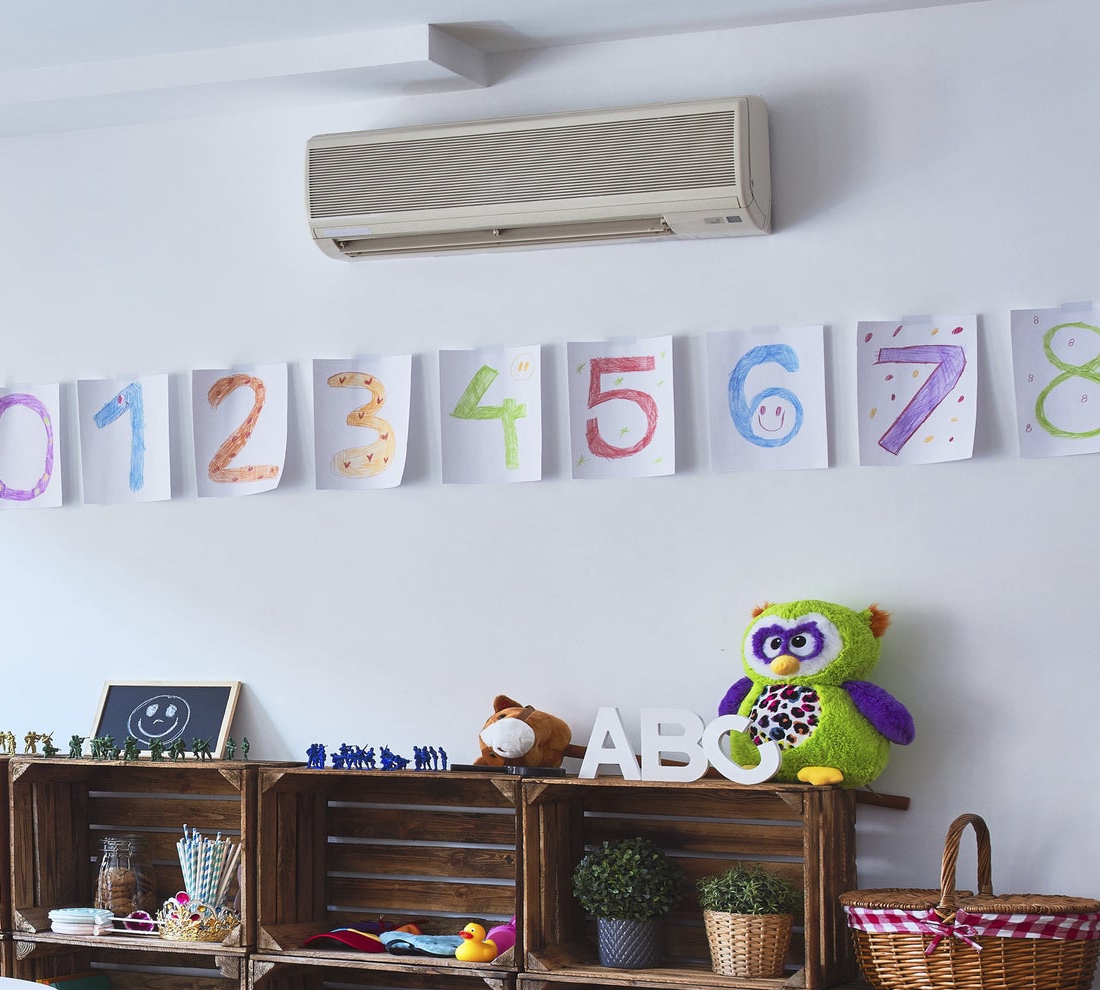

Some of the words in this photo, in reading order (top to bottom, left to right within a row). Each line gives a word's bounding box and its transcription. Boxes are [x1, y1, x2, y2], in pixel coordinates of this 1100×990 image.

[93, 382, 146, 491] 1
[207, 374, 279, 483] 2
[327, 371, 395, 478] 3
[449, 364, 527, 470] 4
[586, 355, 658, 459] 5
[727, 344, 804, 448] 6
[873, 345, 967, 456] 7
[1035, 321, 1100, 439] 8
[578, 707, 782, 785] ABC
